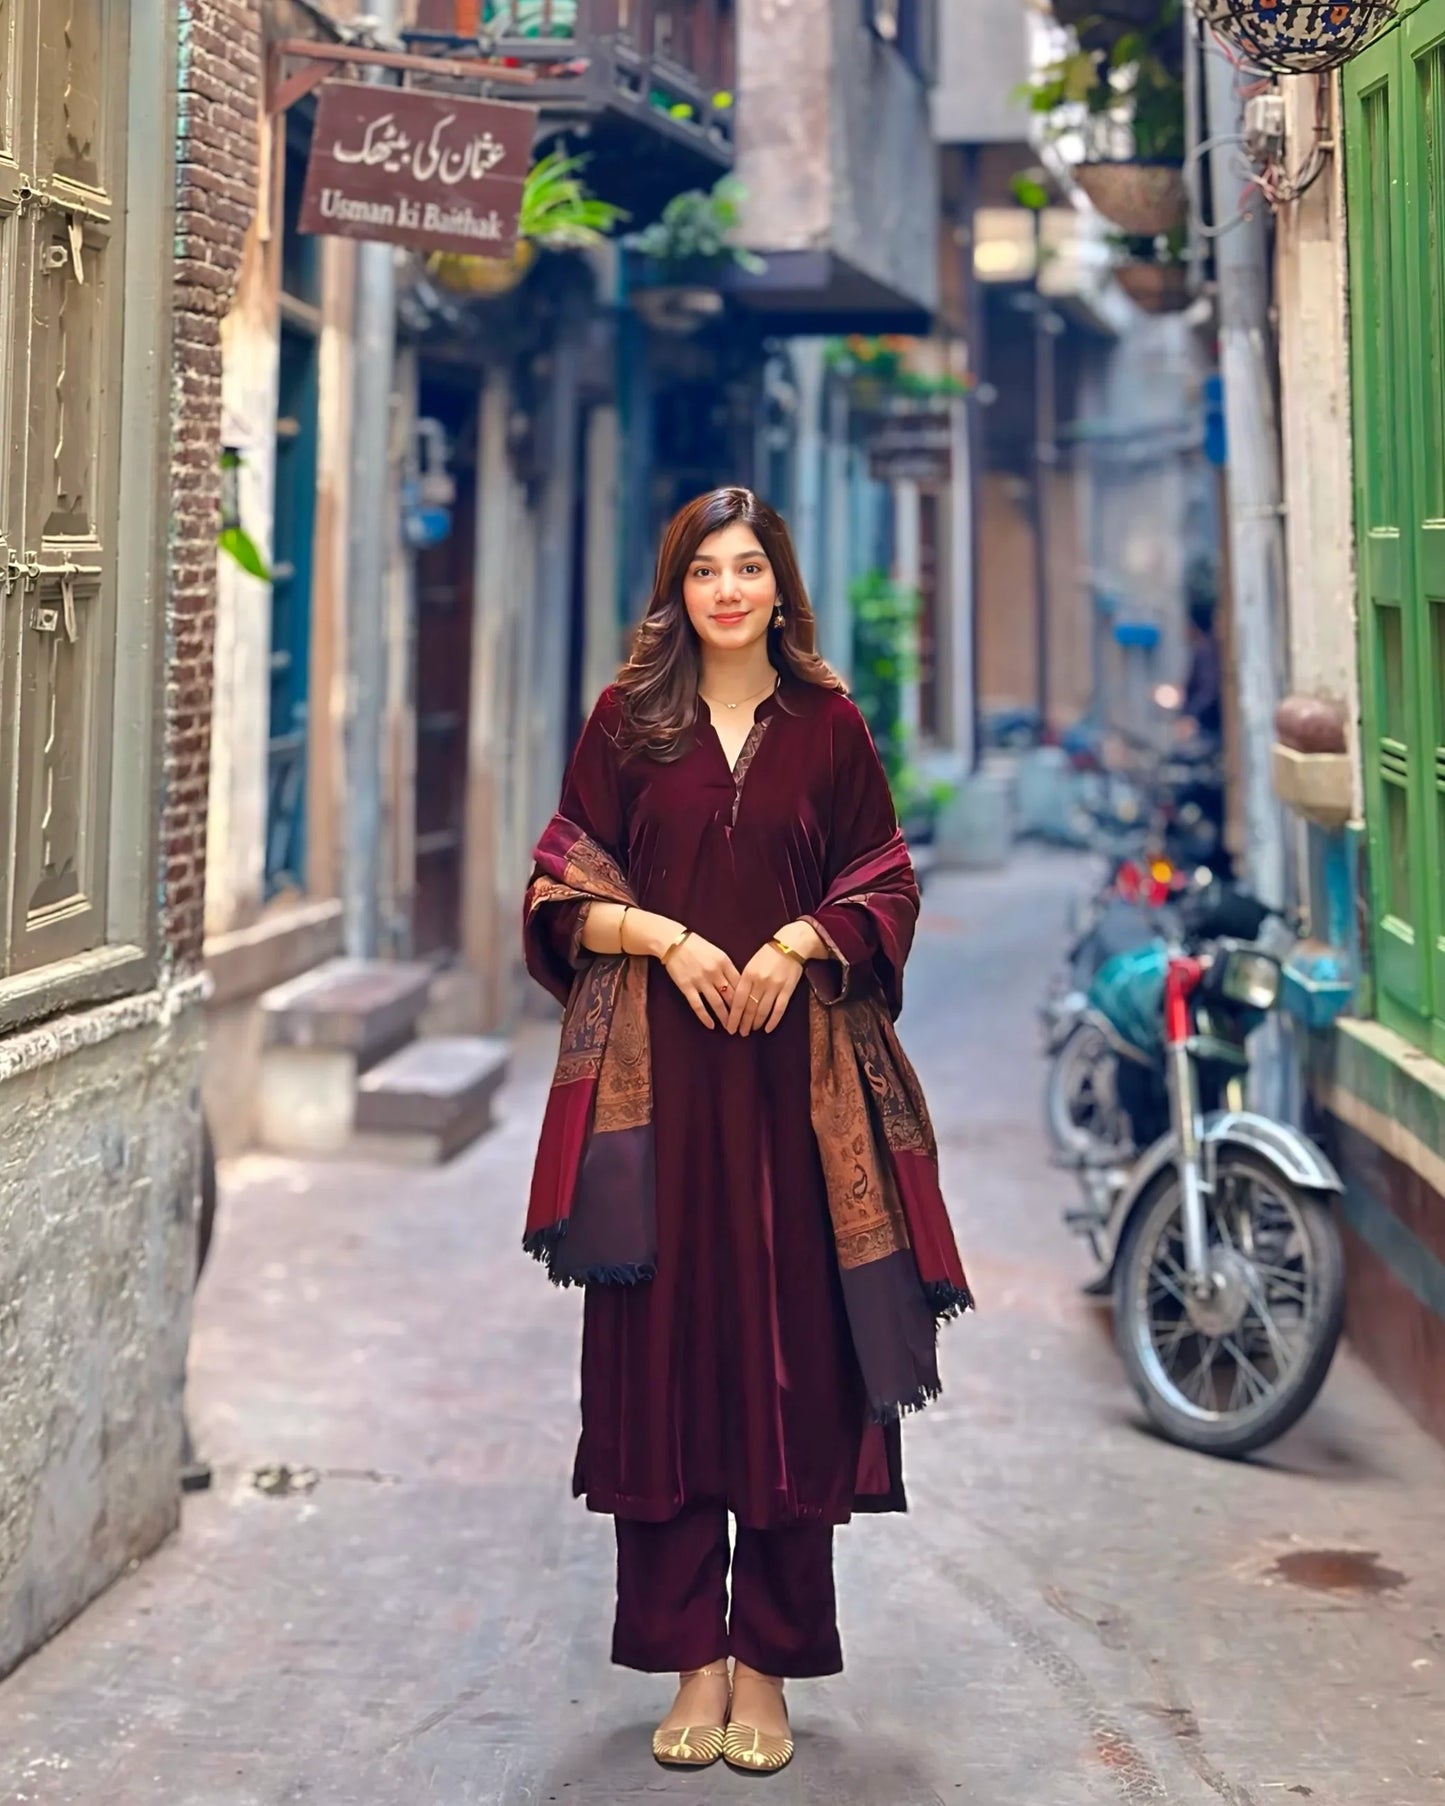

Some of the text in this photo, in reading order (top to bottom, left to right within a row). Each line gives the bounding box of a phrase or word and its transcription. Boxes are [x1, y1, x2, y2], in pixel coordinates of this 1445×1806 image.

[333, 113, 505, 185] عثمان کی بیٹھک
[320, 188, 503, 240] Usman ki Baithak
